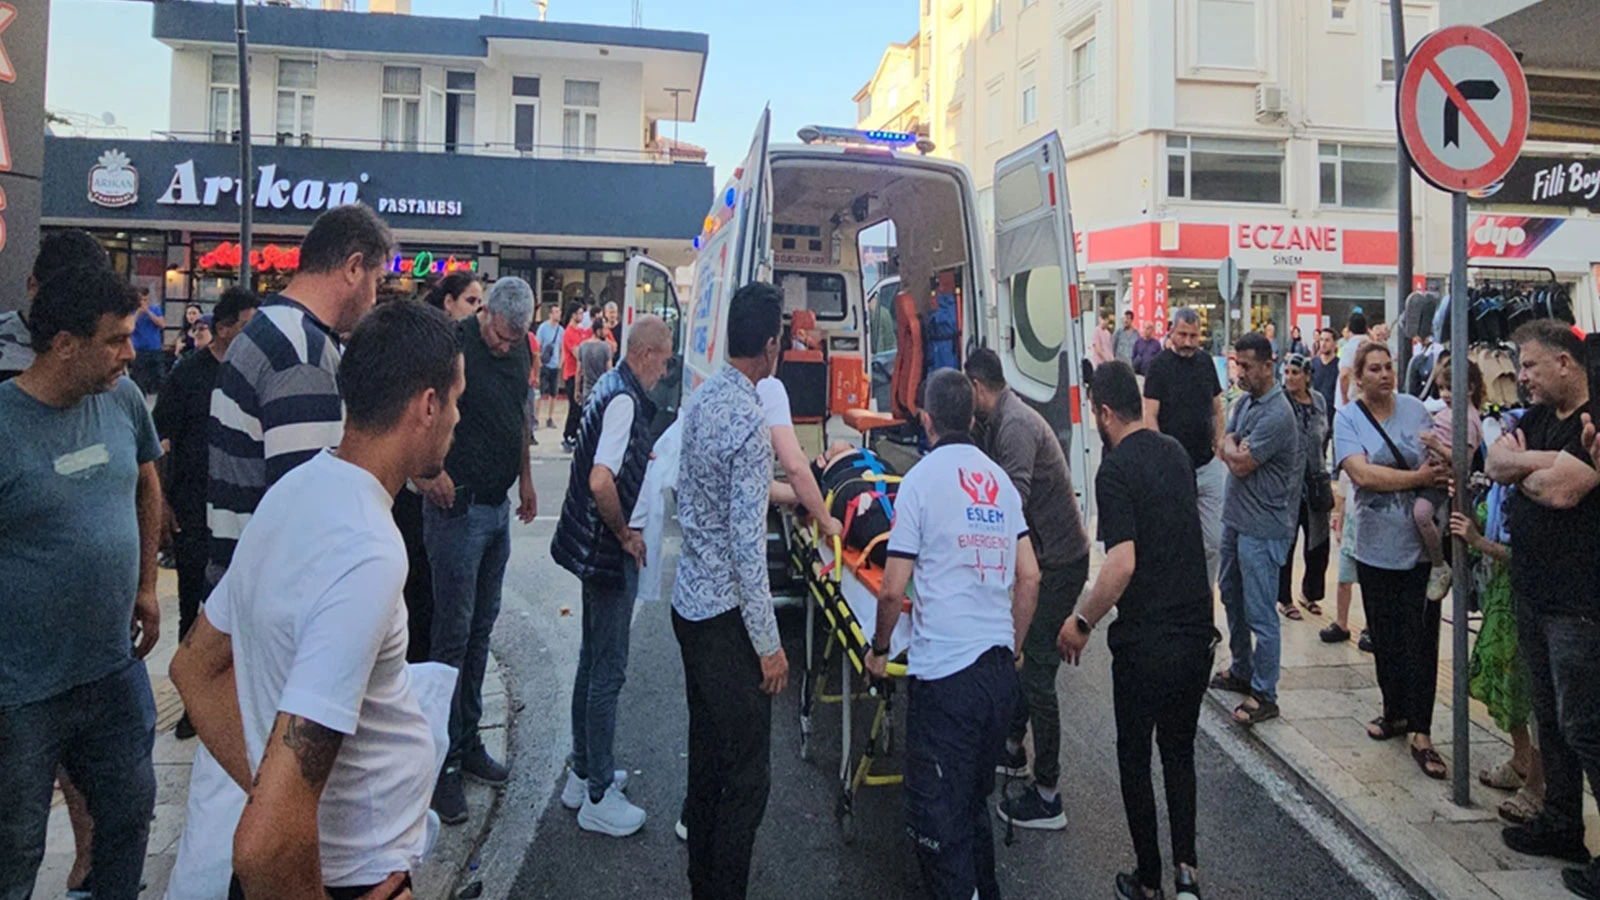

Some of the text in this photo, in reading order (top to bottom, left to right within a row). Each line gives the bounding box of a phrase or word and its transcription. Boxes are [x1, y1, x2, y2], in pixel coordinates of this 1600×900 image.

[1532, 162, 1600, 200] Filli Boy
[1237, 223, 1337, 252] ECZANE
[1474, 216, 1526, 255] dyo
[1301, 283, 1312, 302] E
